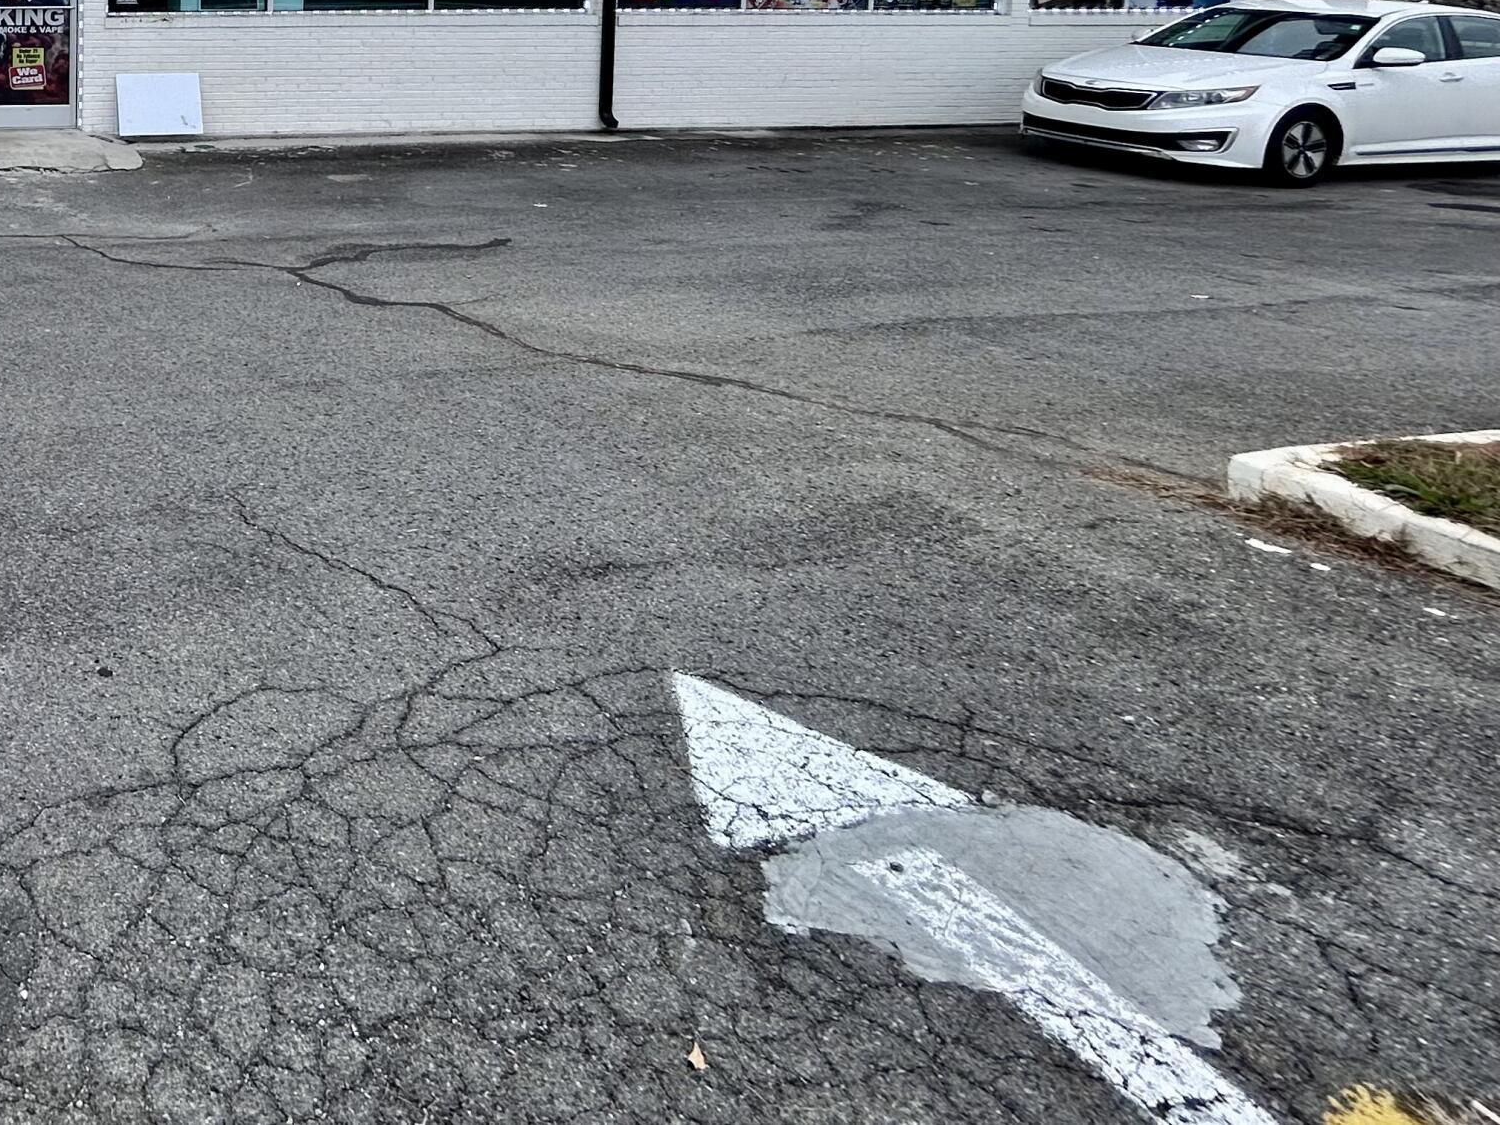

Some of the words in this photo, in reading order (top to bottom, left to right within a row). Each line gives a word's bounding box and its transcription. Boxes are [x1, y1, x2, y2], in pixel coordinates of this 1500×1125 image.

[29, 26, 37, 34] &
[39, 26, 64, 34] VAPE
[16, 67, 38, 76] We
[12, 74, 43, 85] Card
